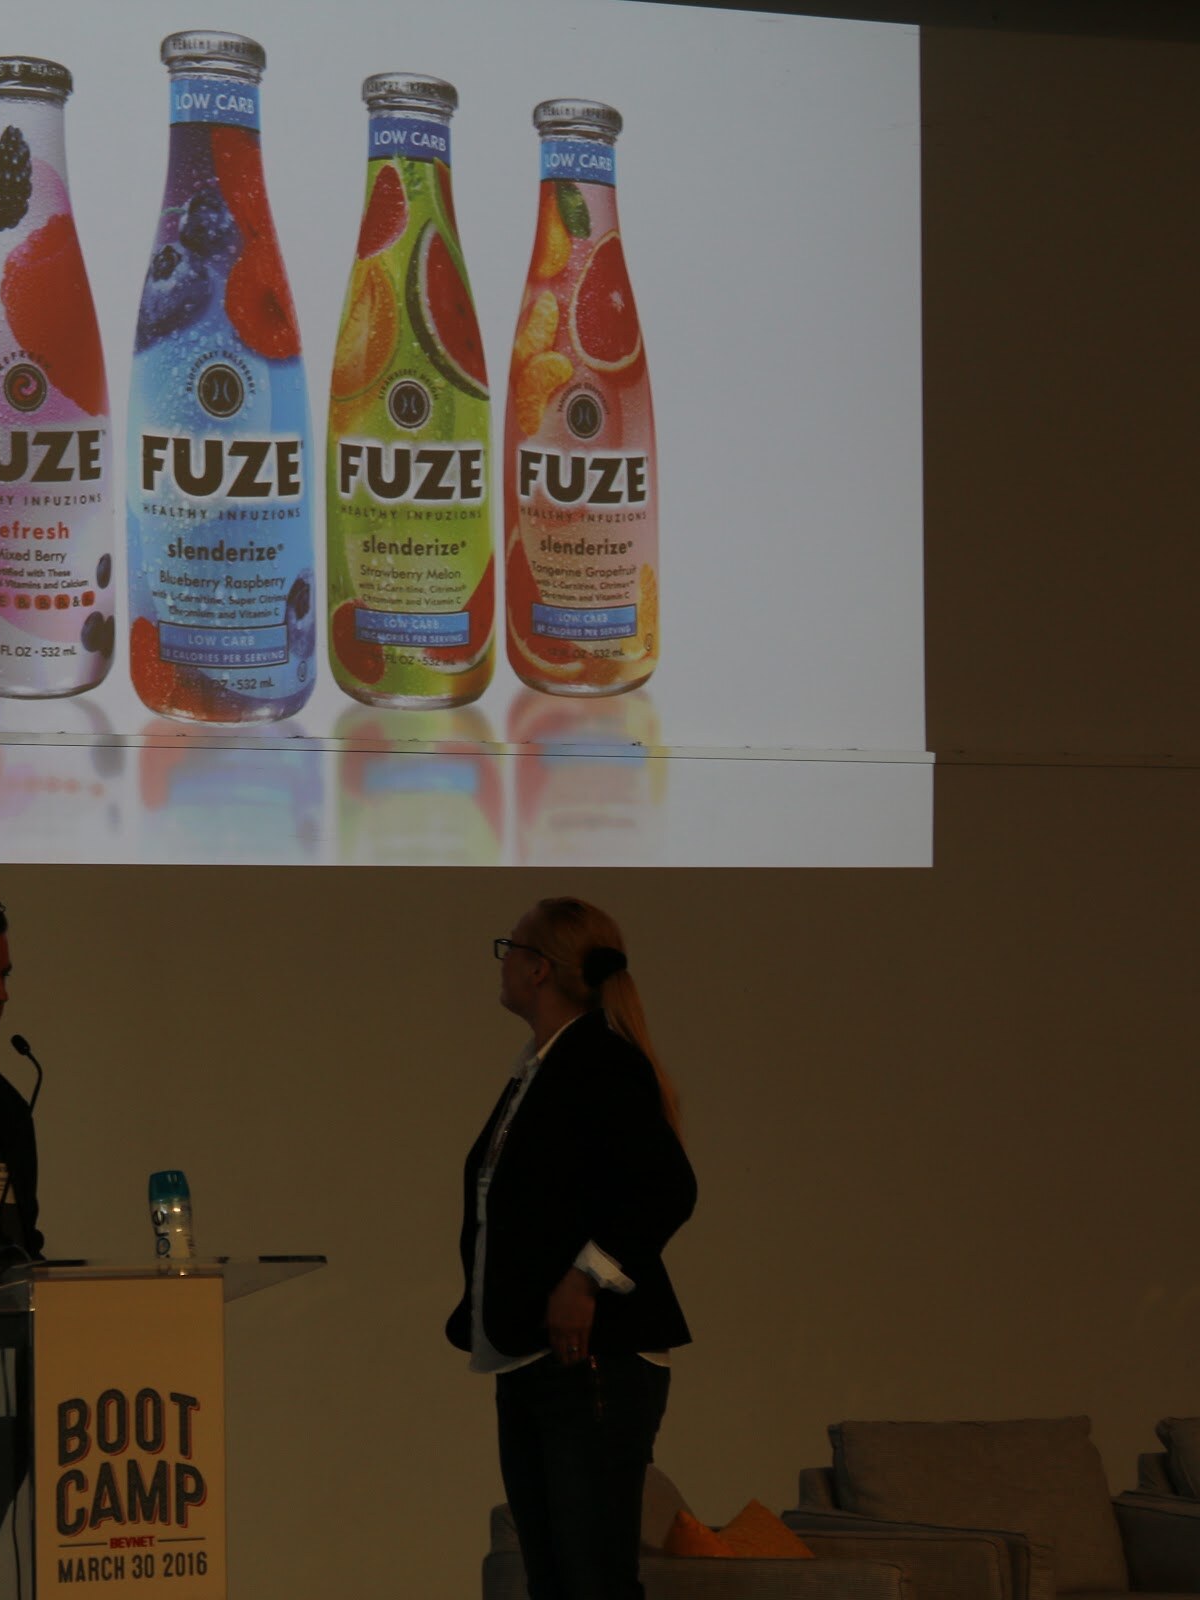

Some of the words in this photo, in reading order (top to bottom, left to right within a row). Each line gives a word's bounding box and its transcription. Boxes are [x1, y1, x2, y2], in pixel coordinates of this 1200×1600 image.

[177, 93, 210, 110] LOW
[215, 94, 255, 114] CARB
[374, 130, 408, 145] LOW
[410, 131, 446, 152] CARB
[545, 153, 575, 168] LOW
[578, 154, 613, 172] CARB
[142, 434, 301, 497] FUZE
[340, 443, 482, 499] FUZE
[520, 449, 647, 504] FUZE
[24, 493, 102, 507] INFUZIONS
[143, 504, 208, 520] HEALTHY
[218, 507, 301, 521] INFUZIONS
[35, 550, 67, 564] Berry
[27, 568, 45, 577] with
[360, 564, 423, 582] Strawberry
[427, 568, 461, 579] Melon
[532, 560, 581, 577] Tangerine
[585, 564, 636, 577] Grapefruit
[43, 580, 58, 589] and
[61, 579, 89, 589] Calcium
[159, 570, 220, 592] Blueberry
[225, 573, 286, 592] Raspberry
[218, 609, 236, 619] and
[384, 618, 407, 628] LOW
[412, 620, 440, 630] CARB
[188, 633, 216, 646] LOW
[221, 635, 256, 647] CARB
[0, 645, 12, 656] FL
[15, 646, 32, 657] OZ
[41, 647, 60, 657] 532
[173, 649, 219, 663] CALORIES
[223, 653, 241, 663] PER
[245, 650, 285, 663] SERVING
[399, 656, 415, 665] OZ
[237, 678, 256, 690] 532
[58, 1388, 200, 1467] BOOT
[56, 1459, 207, 1537] CAMP
[110, 1535, 155, 1549] BEVNET
[58, 1556, 125, 1583] MARCH
[132, 1554, 155, 1579] 30
[163, 1551, 208, 1578] 2016
